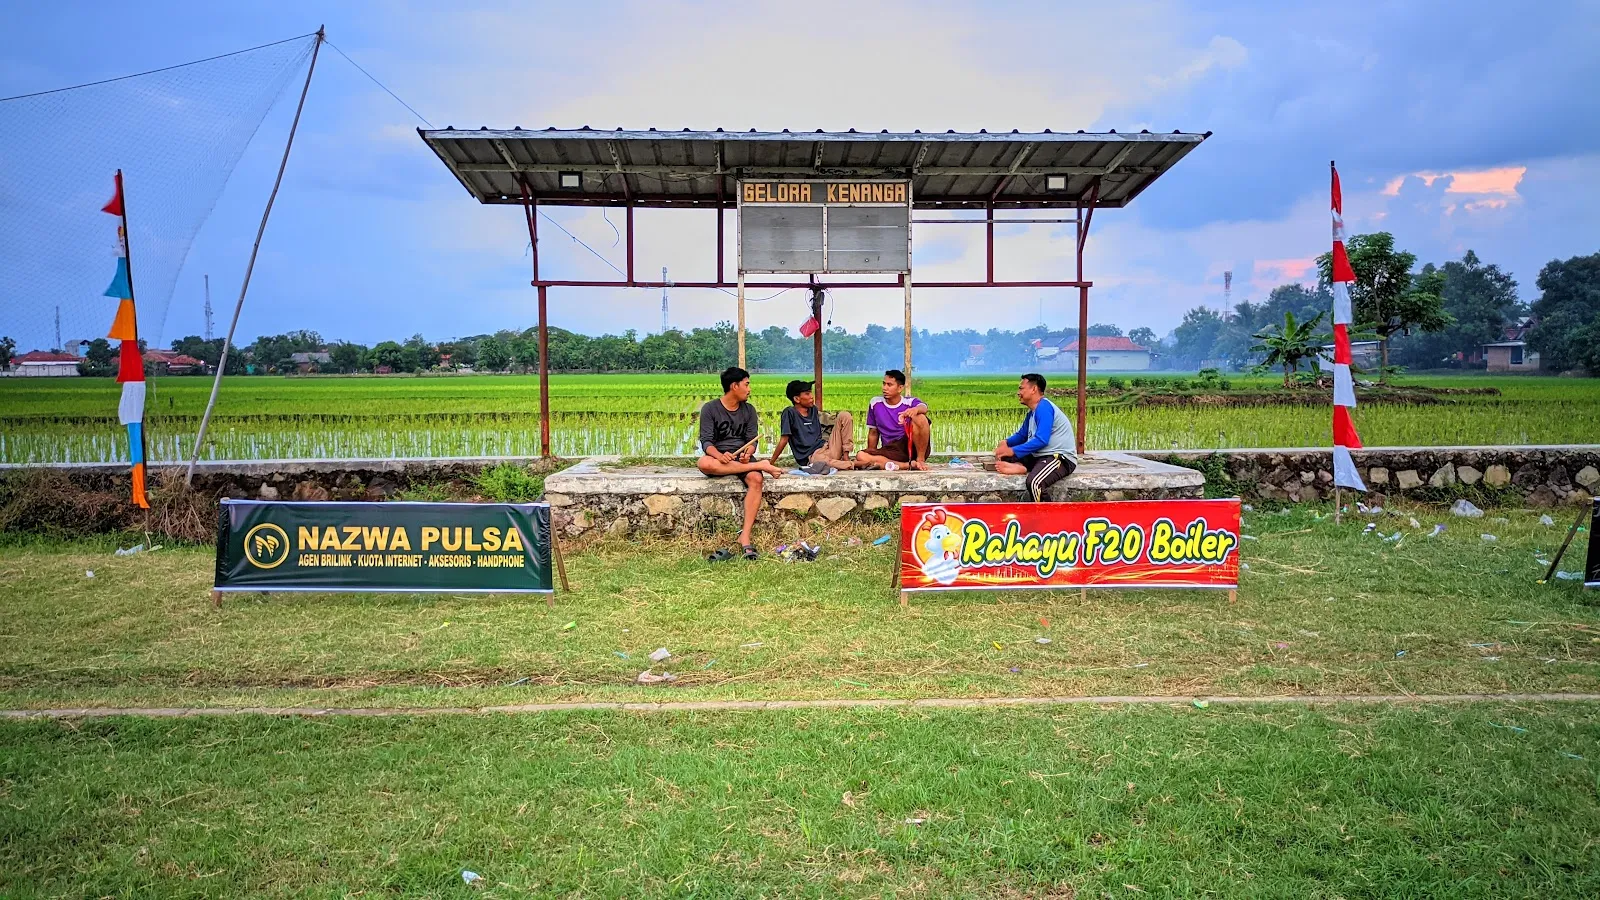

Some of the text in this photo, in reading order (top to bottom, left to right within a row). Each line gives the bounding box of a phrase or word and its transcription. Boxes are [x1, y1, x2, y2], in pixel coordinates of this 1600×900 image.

[743, 183, 906, 202] GELORA KENANGA
[298, 526, 524, 552] NAZWA PULSA
[961, 519, 1235, 574] Rahayu F20 Boiler
[298, 553, 525, 568] AGEN BRILINK KUOTA INTERNET AKSESORIS HANDPHONE
